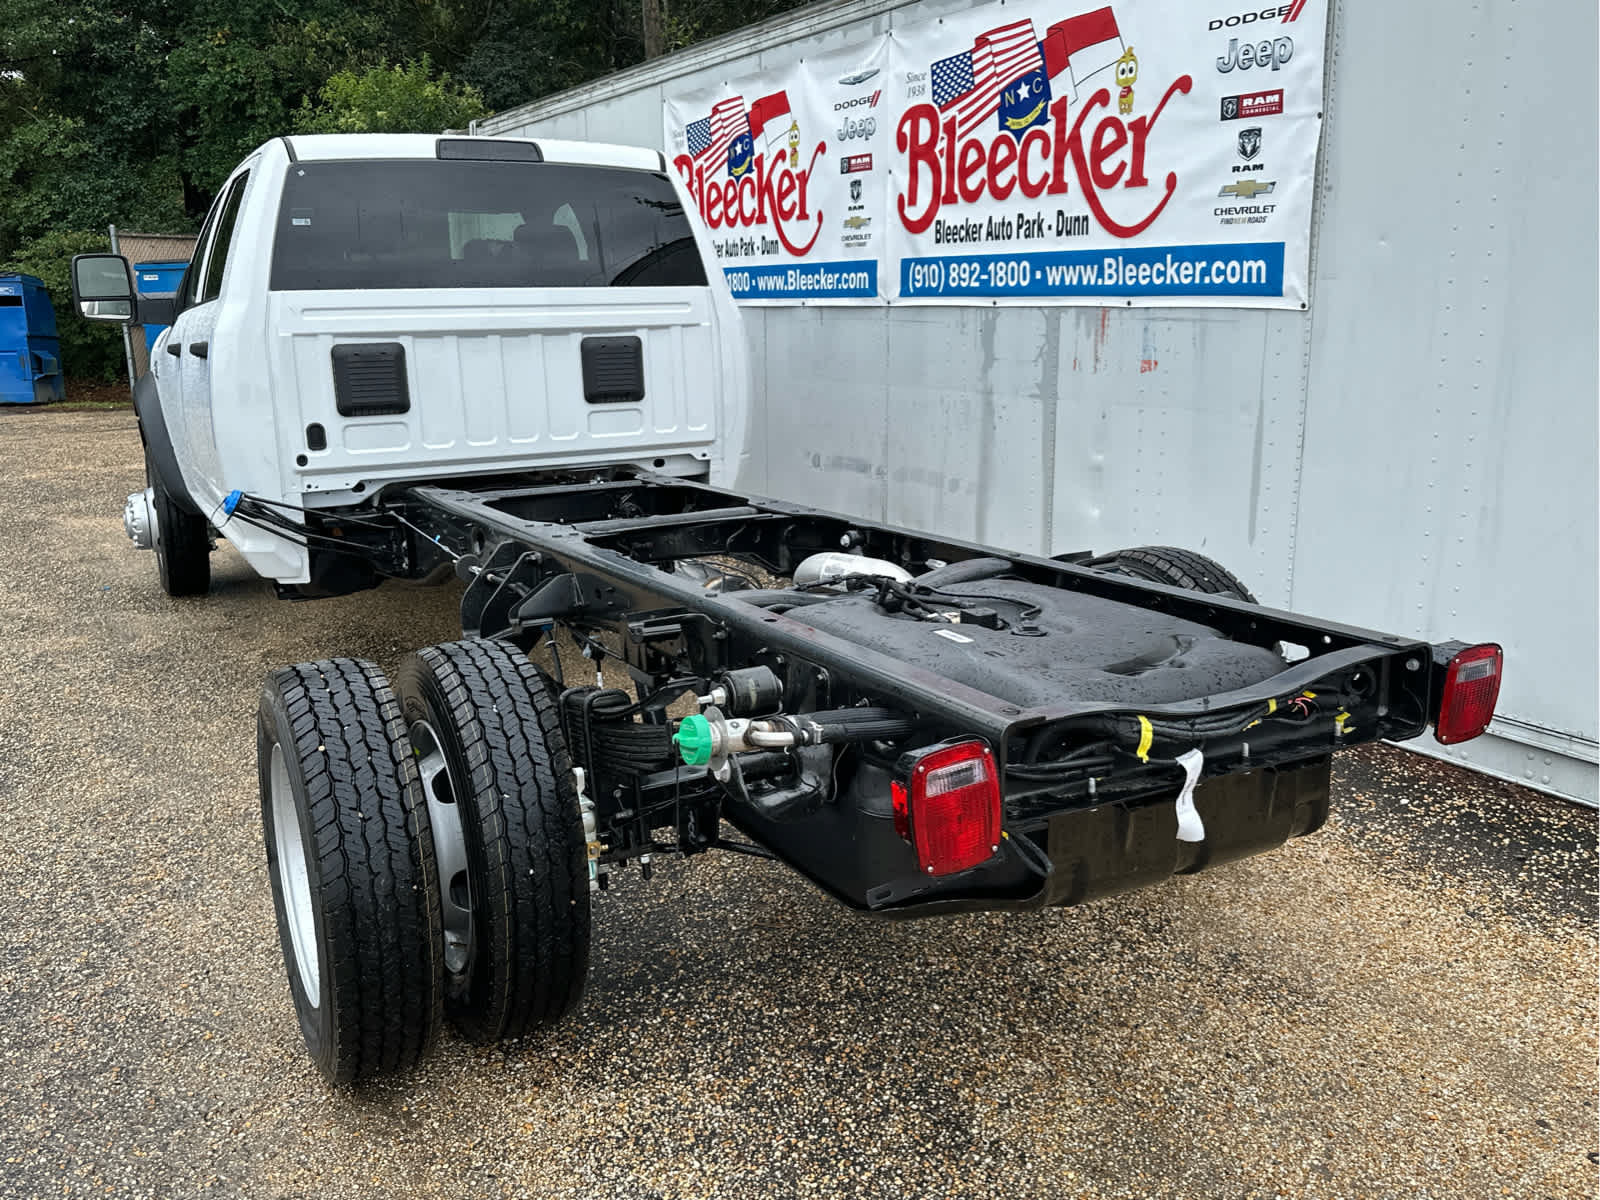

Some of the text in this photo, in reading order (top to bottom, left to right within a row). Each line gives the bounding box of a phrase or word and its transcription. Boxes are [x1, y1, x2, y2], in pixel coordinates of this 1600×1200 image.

[1208, 4, 1292, 31] DODGE
[1216, 36, 1294, 73] Jeep
[905, 72, 927, 85] Since
[907, 84, 926, 98] 1938
[1005, 77, 1043, 108] N C
[1242, 94, 1280, 107] RAM
[834, 95, 873, 111] DODGE
[837, 116, 876, 141] Jeep
[1232, 164, 1264, 173] RAM
[1214, 204, 1277, 216] CHEVROLET
[935, 209, 1089, 244] Bleecker Auto Park Dunn
[725, 237, 739, 258] Auto
[740, 236, 755, 257] Park
[761, 235, 779, 256] Dunn
[757, 268, 869, 291] www.Bleecker.com
[909, 254, 1266, 293] (910) 892-1800 www.Bleecker.com
